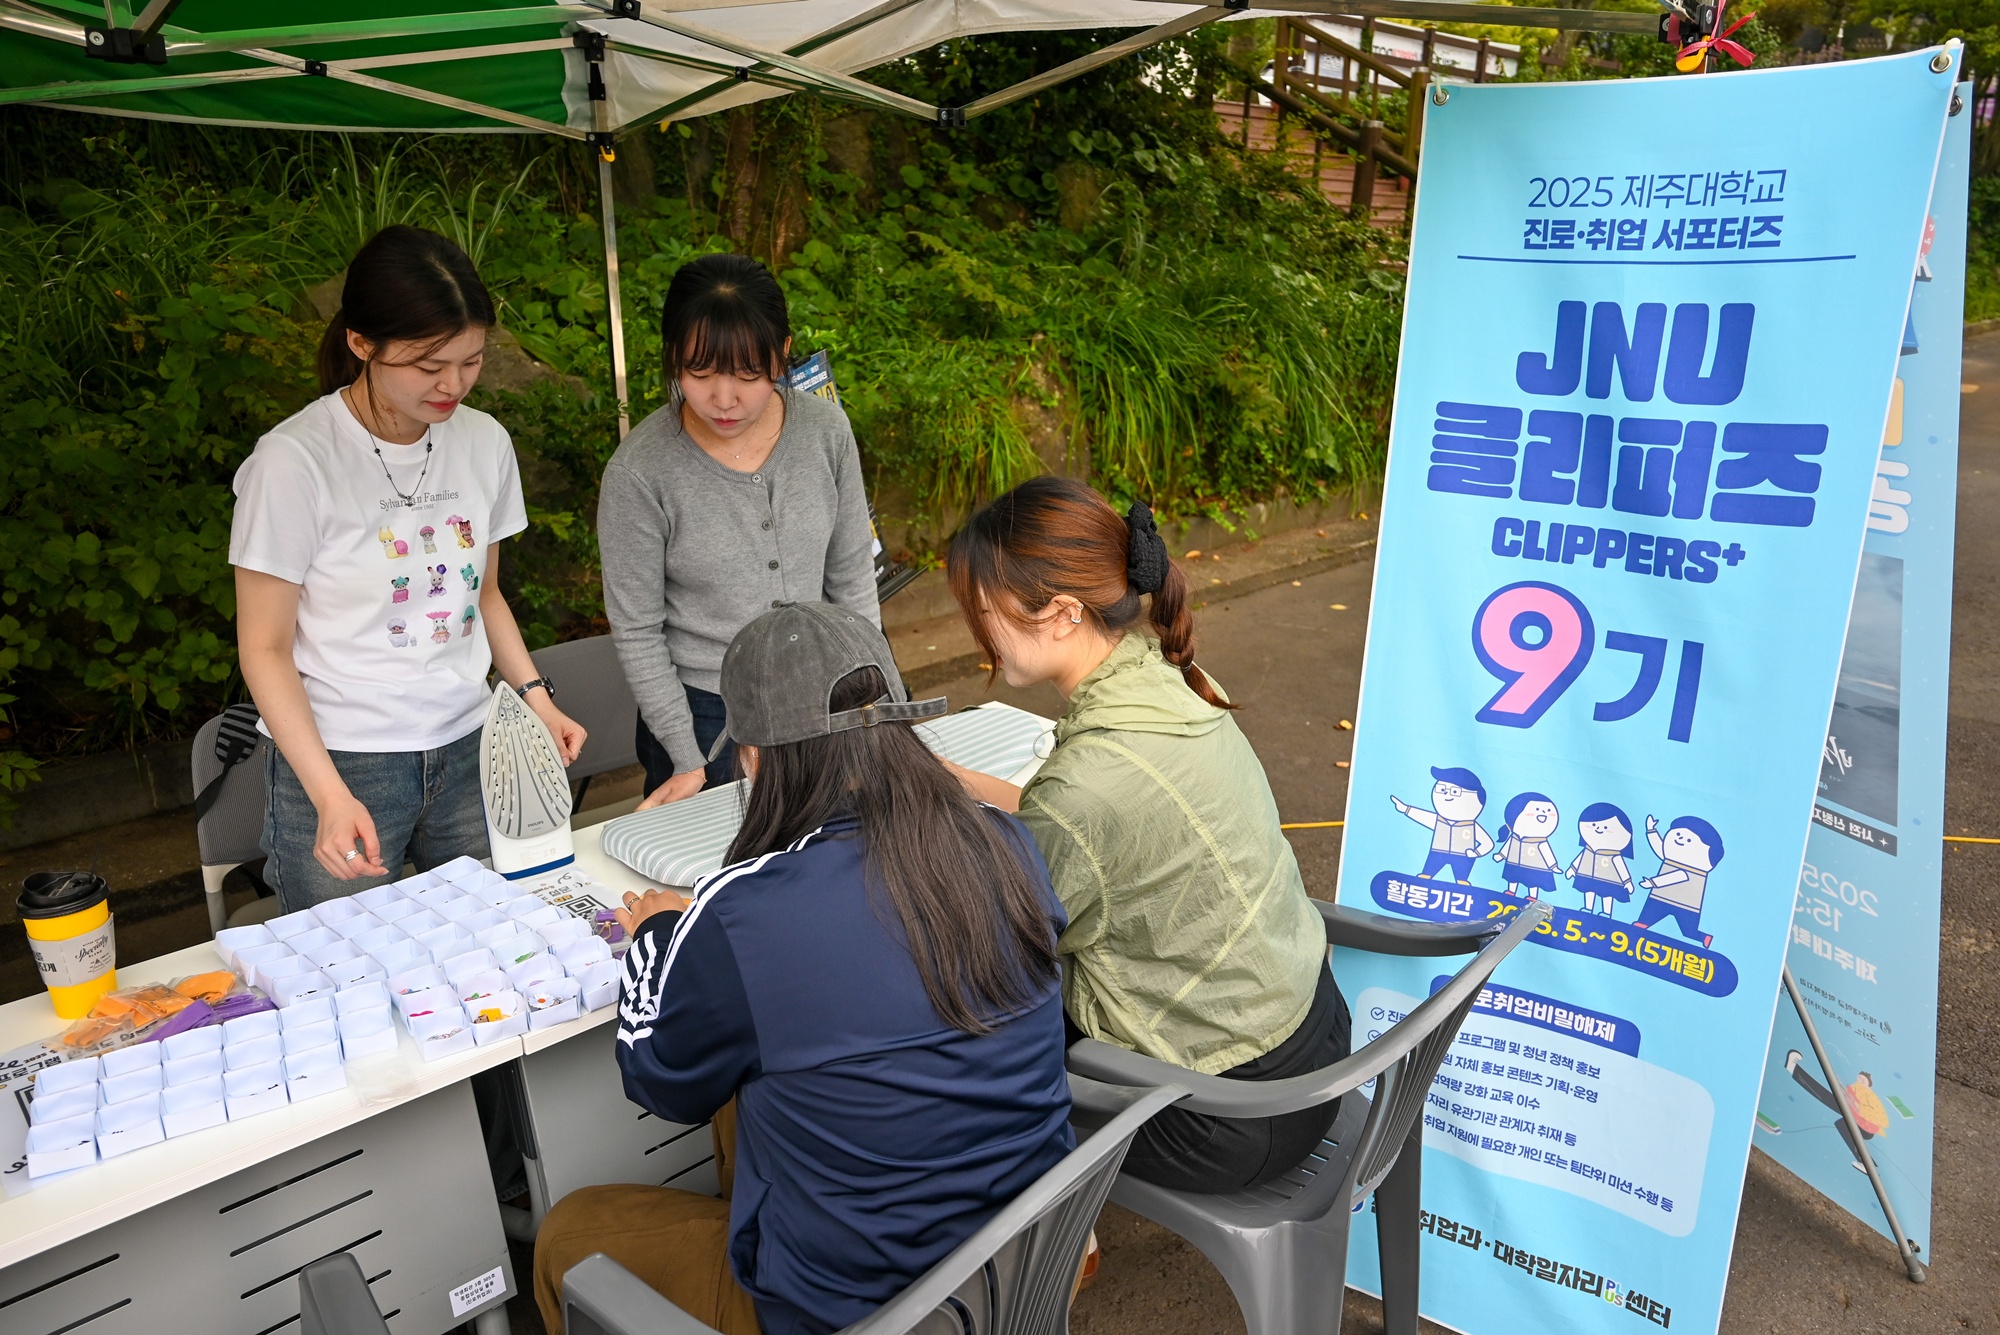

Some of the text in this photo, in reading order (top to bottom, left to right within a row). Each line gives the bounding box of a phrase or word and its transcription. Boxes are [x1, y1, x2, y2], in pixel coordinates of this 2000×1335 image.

[1528, 168, 1786, 209] 2025 제주대학교
[1523, 214, 1783, 251] 진로·취업 서포터즈
[1515, 300, 1755, 406] JNU
[1427, 400, 1829, 527] 클리퍼즈
[379, 490, 459, 511] Sylvanan Families
[1491, 517, 1746, 583] CLIPPERS+
[1471, 580, 1705, 744] 9기
[528, 820, 544, 828] PHILIPS
[1386, 879, 1473, 917] 활동기간
[1473, 989, 1615, 1043] 로취업비밀해제
[1442, 1053, 1599, 1103] 원 자체 홍보 콘텐츠 기획·운영
[1458, 1032, 1506, 1052] 프로그램
[1508, 1041, 1521, 1056] 및
[1522, 1045, 1548, 1063] 청년
[1549, 1052, 1574, 1070] 정책
[1575, 1061, 1601, 1079] 홍보
[1432, 1073, 1540, 1110] 업역량 강화 교육 이수
[1425, 1092, 1577, 1147] 자리 유관기관 관계자 취재 등
[1423, 1114, 1674, 1213] 취업 지원에 필요한 개인 또는 팀단위 미션 수행 등
[1420, 1209, 1482, 1251] 취업과
